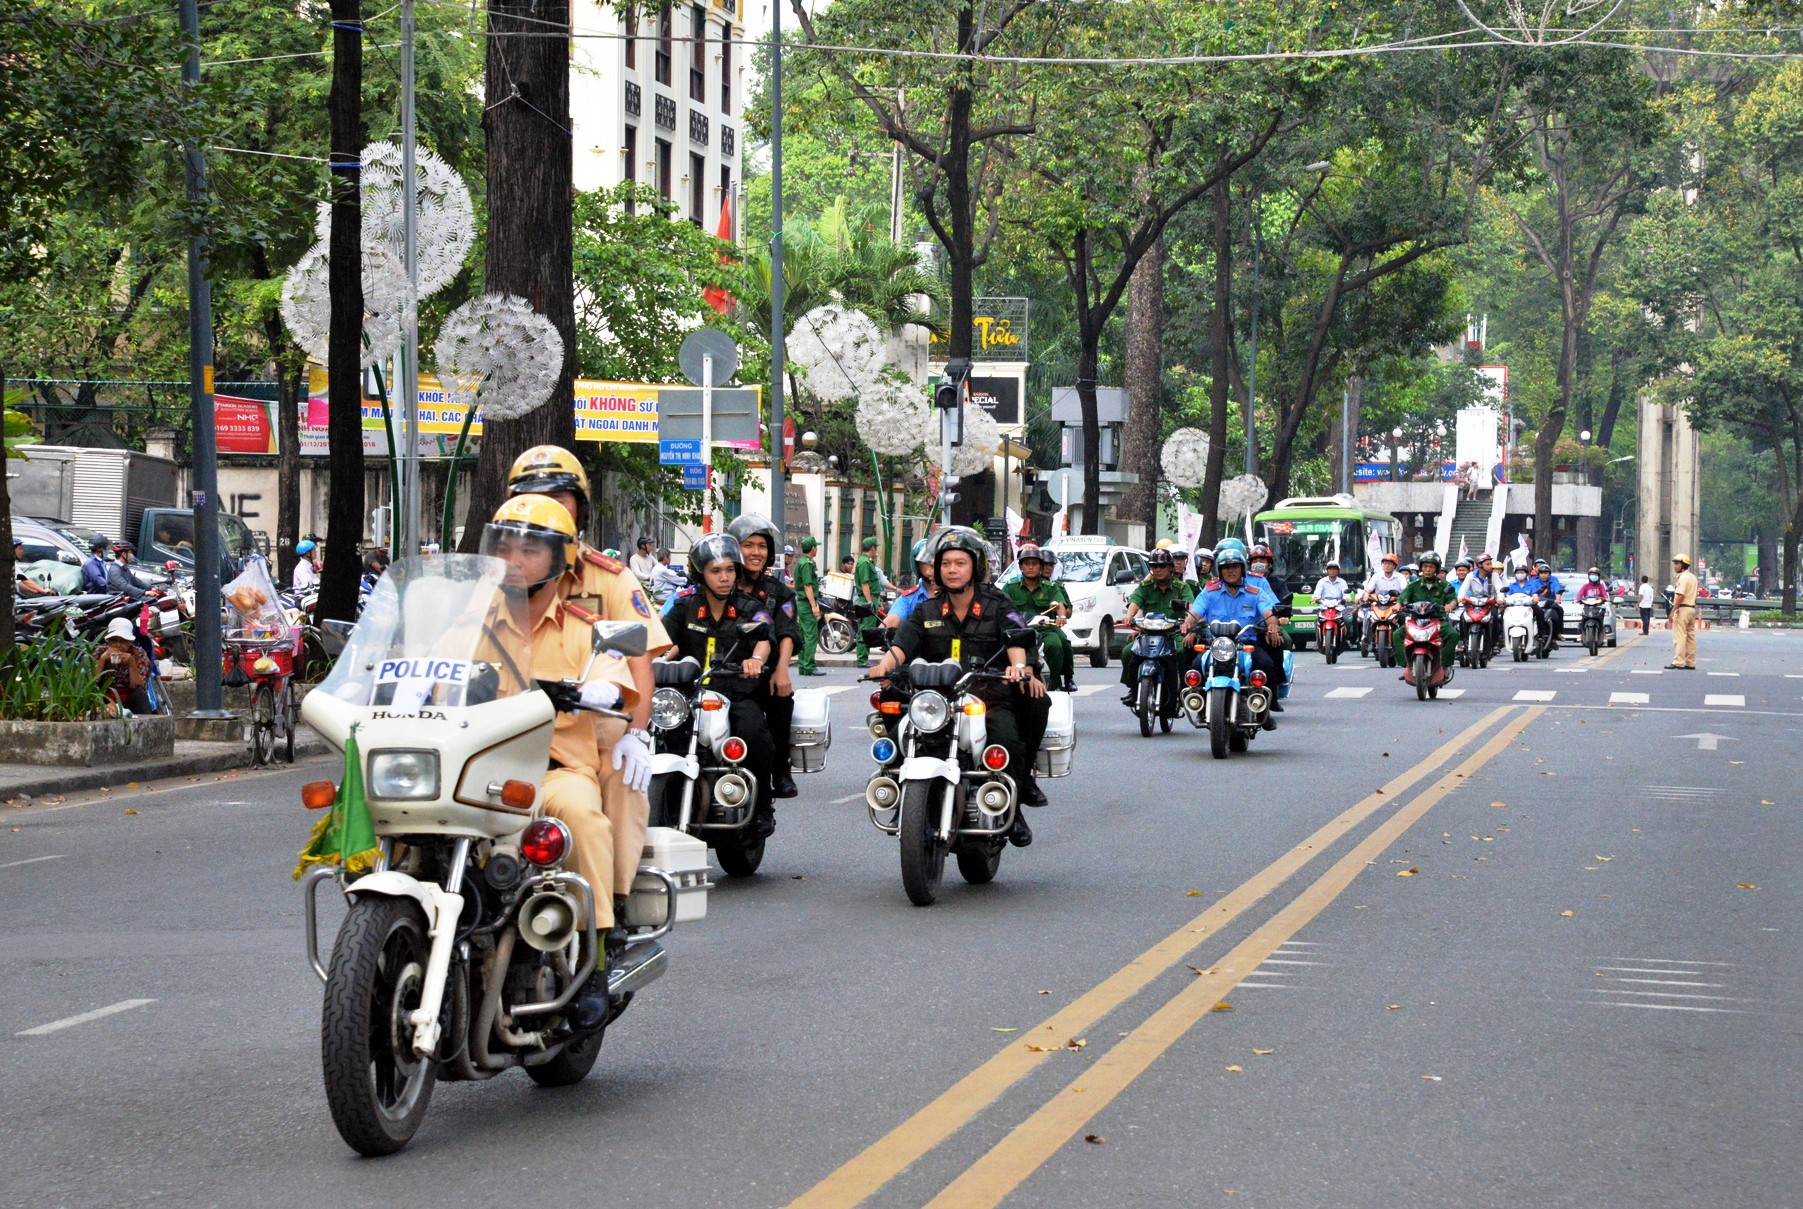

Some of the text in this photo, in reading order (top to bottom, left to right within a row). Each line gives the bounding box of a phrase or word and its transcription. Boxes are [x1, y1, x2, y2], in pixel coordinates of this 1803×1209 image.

[589, 394, 637, 412] KHÔNG
[622, 420, 649, 431] DANH
[670, 441, 693, 449] ĐƯỜNG
[378, 660, 467, 682] POLICE
